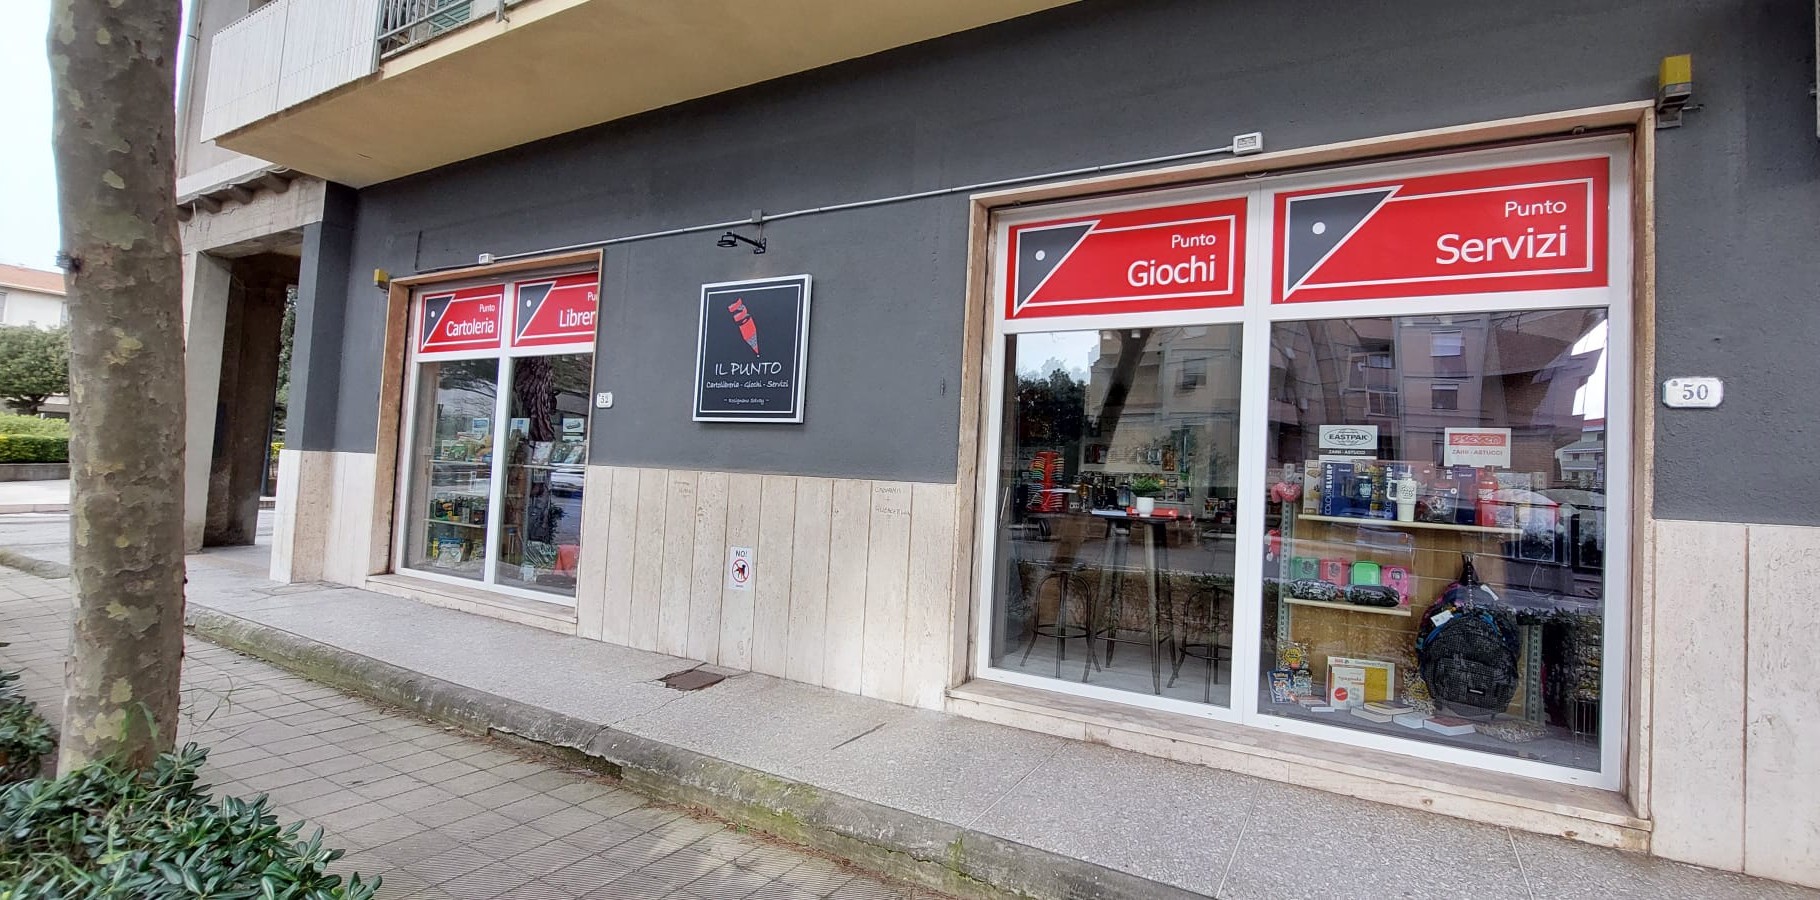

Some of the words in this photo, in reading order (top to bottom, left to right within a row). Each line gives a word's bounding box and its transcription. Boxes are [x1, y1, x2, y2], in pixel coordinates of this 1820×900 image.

[1504, 200, 1567, 217] Punto
[1171, 234, 1216, 248] Punto
[1435, 225, 1567, 265] Servizi
[1127, 254, 1216, 287] Giochi
[479, 303, 495, 313] Punto
[446, 317, 494, 337] Cartoleria
[715, 363, 728, 376] IL
[731, 362, 782, 376] PUNTO
[706, 380, 739, 389] Cartolibreria
[744, 380, 762, 388] Giochi
[766, 380, 789, 388] Servizi
[1683, 384, 1708, 400] 50
[735, 550, 748, 558] NO!
